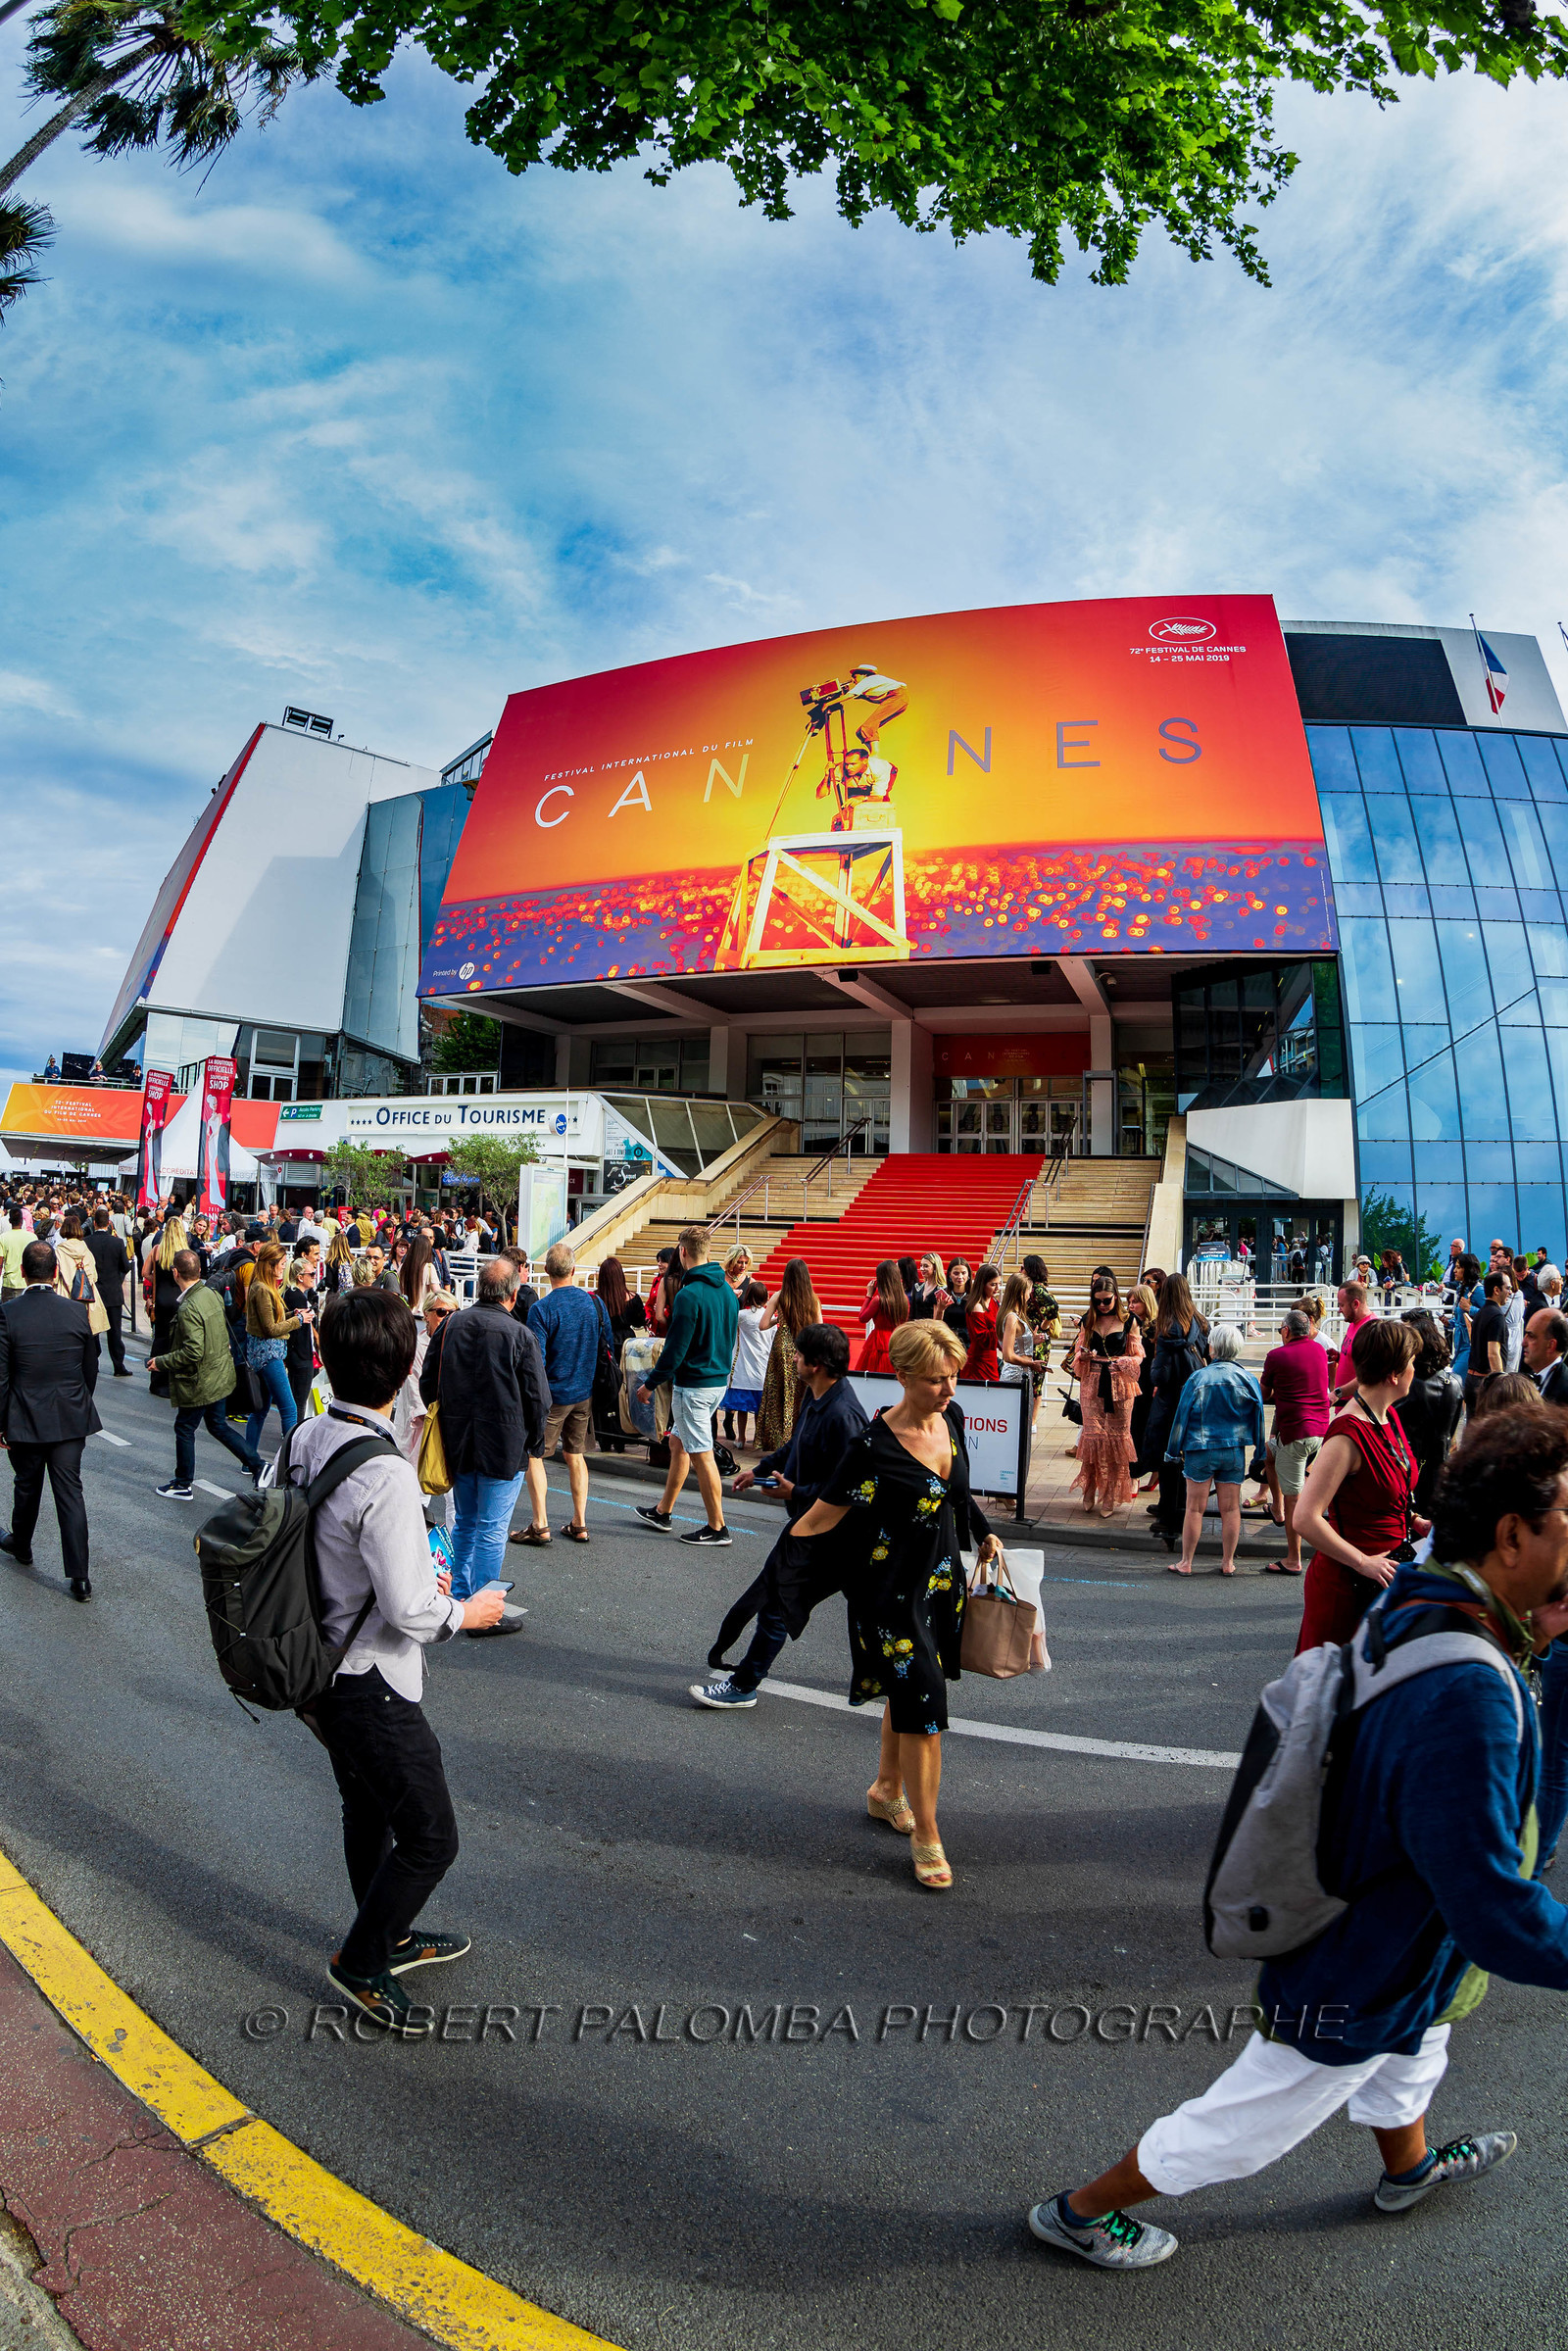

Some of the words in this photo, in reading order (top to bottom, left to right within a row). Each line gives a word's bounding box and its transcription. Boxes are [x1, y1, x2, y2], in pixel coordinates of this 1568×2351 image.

[544, 765, 596, 782] FESTIVAL
[601, 748, 695, 771] INTERNATIONAL
[702, 743, 718, 754] DU
[724, 738, 754, 750] FILM
[534, 715, 1202, 829] CANNES
[460, 962, 475, 980] hp
[207, 1064, 234, 1075] OFFICIELLE
[147, 1076, 170, 1088] OFFICIELLE
[209, 1079, 229, 1091] SHOP
[147, 1089, 164, 1101] SHOP
[375, 1106, 430, 1126] OFFICE
[457, 1104, 546, 1124] TOURISME
